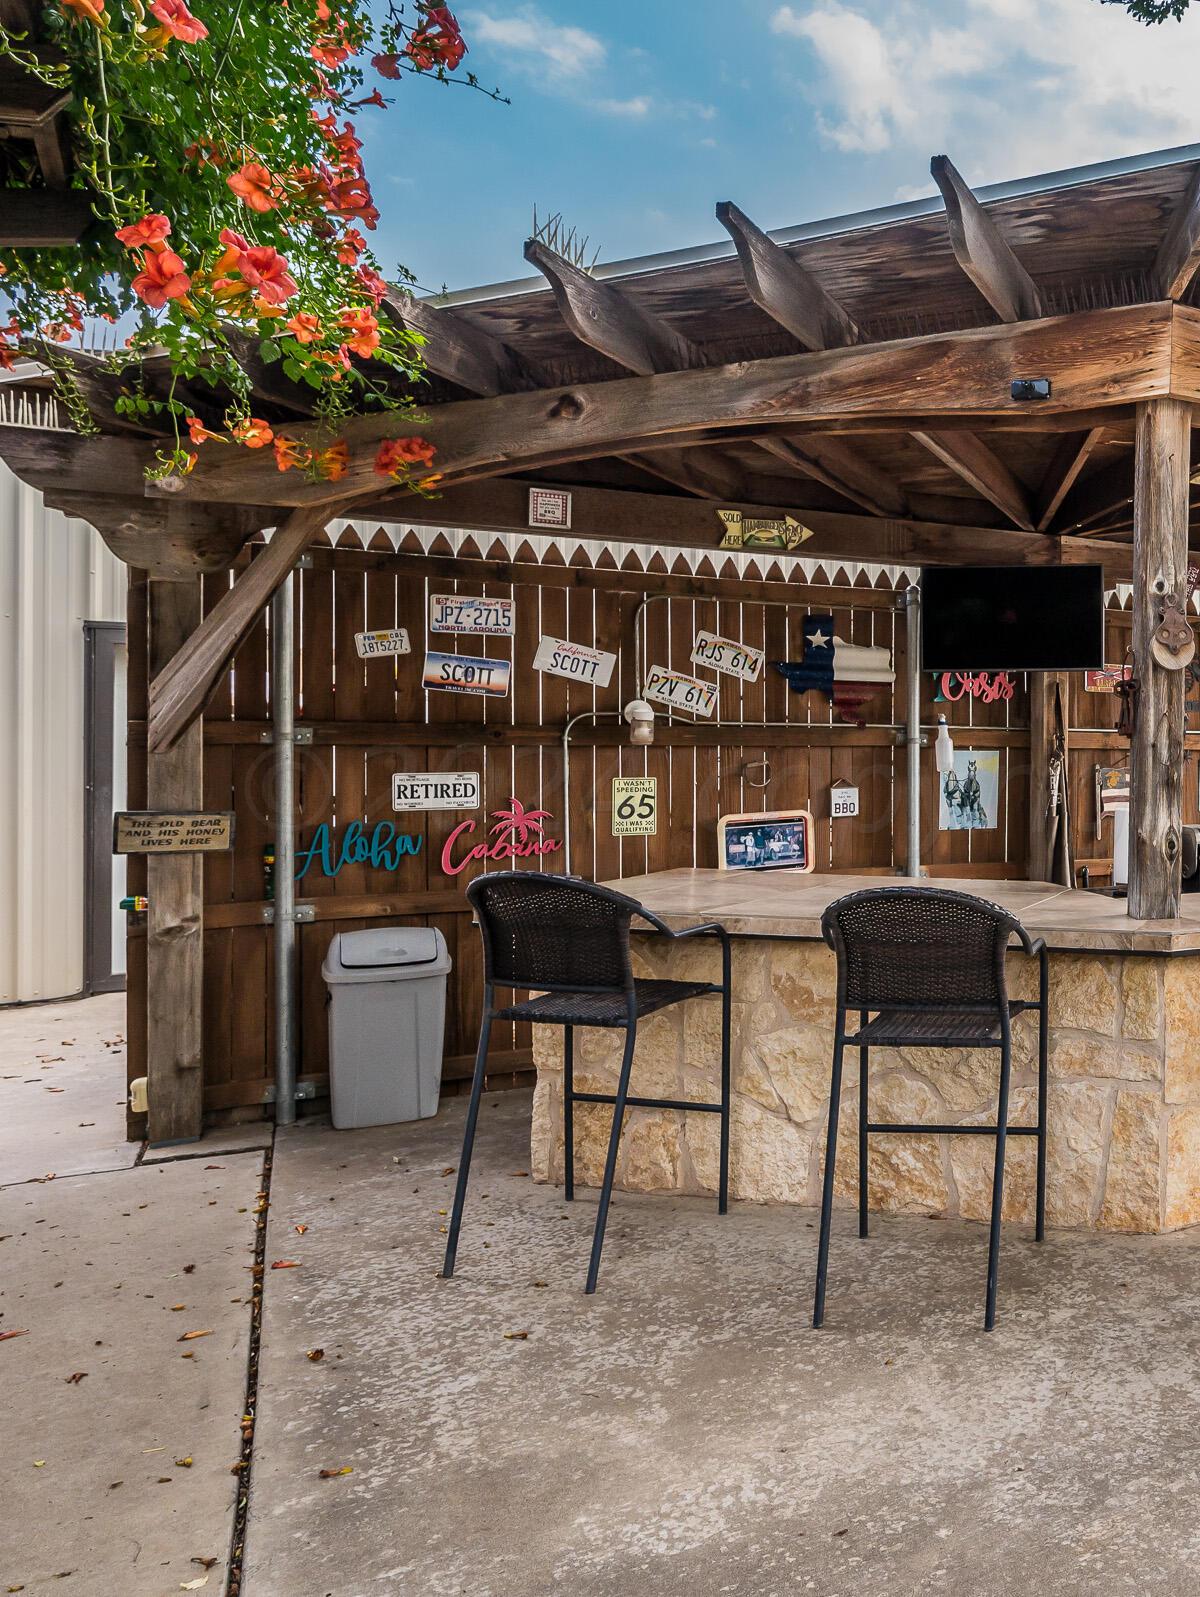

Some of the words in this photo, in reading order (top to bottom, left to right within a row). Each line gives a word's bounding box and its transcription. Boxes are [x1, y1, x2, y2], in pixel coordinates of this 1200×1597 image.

[723, 512, 741, 524] SOLD
[743, 520, 786, 535] HAMBURGERS
[725, 535, 742, 545] HERE
[696, 638, 726, 662] RJS
[731, 652, 759, 675] 614
[551, 652, 600, 678] SCOTT
[708, 661, 724, 670] ALOHA
[726, 666, 740, 676] STATE
[440, 663, 495, 686] SCOTT
[648, 673, 679, 697] PZV
[685, 686, 715, 708] 617
[661, 696, 678, 705] ALOHA
[679, 700, 693, 710] STATE
[396, 782, 476, 800] RETIRED
[617, 794, 655, 820] 65
[131, 820, 153, 828] THE
[160, 820, 184, 828] OLD
[191, 819, 221, 828] BEAR
[158, 829, 180, 837] HIS
[186, 828, 225, 836] HONEY
[141, 839, 172, 847] LIVES
[180, 837, 212, 846] HERE
[294, 819, 423, 880] Aloha
[441, 819, 564, 876] Cabana
